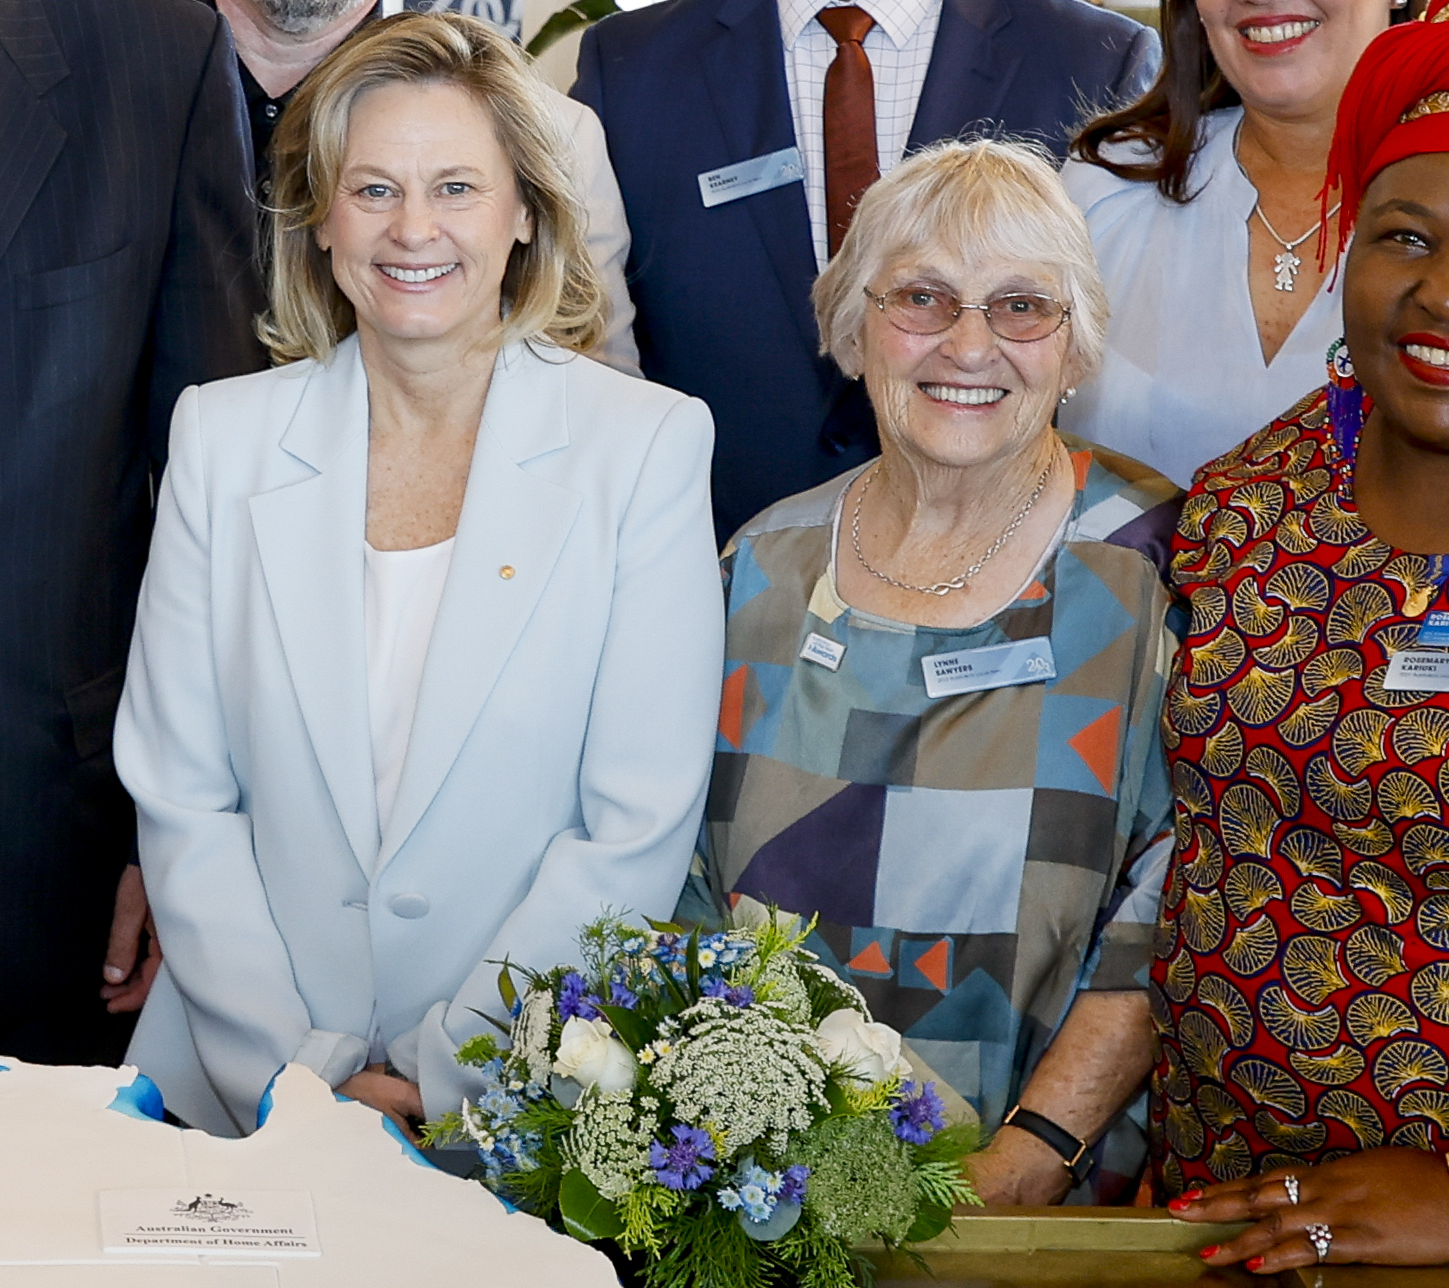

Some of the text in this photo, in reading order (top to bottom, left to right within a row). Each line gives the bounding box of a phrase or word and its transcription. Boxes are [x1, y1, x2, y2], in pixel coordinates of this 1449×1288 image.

[933, 658, 959, 669] LYNNE
[935, 664, 973, 677] SAWYERS
[135, 1225, 294, 1235] Australian Government
[125, 1237, 203, 1246] Department
[221, 1239, 260, 1247] Home
[263, 1240, 308, 1248] Affairs
